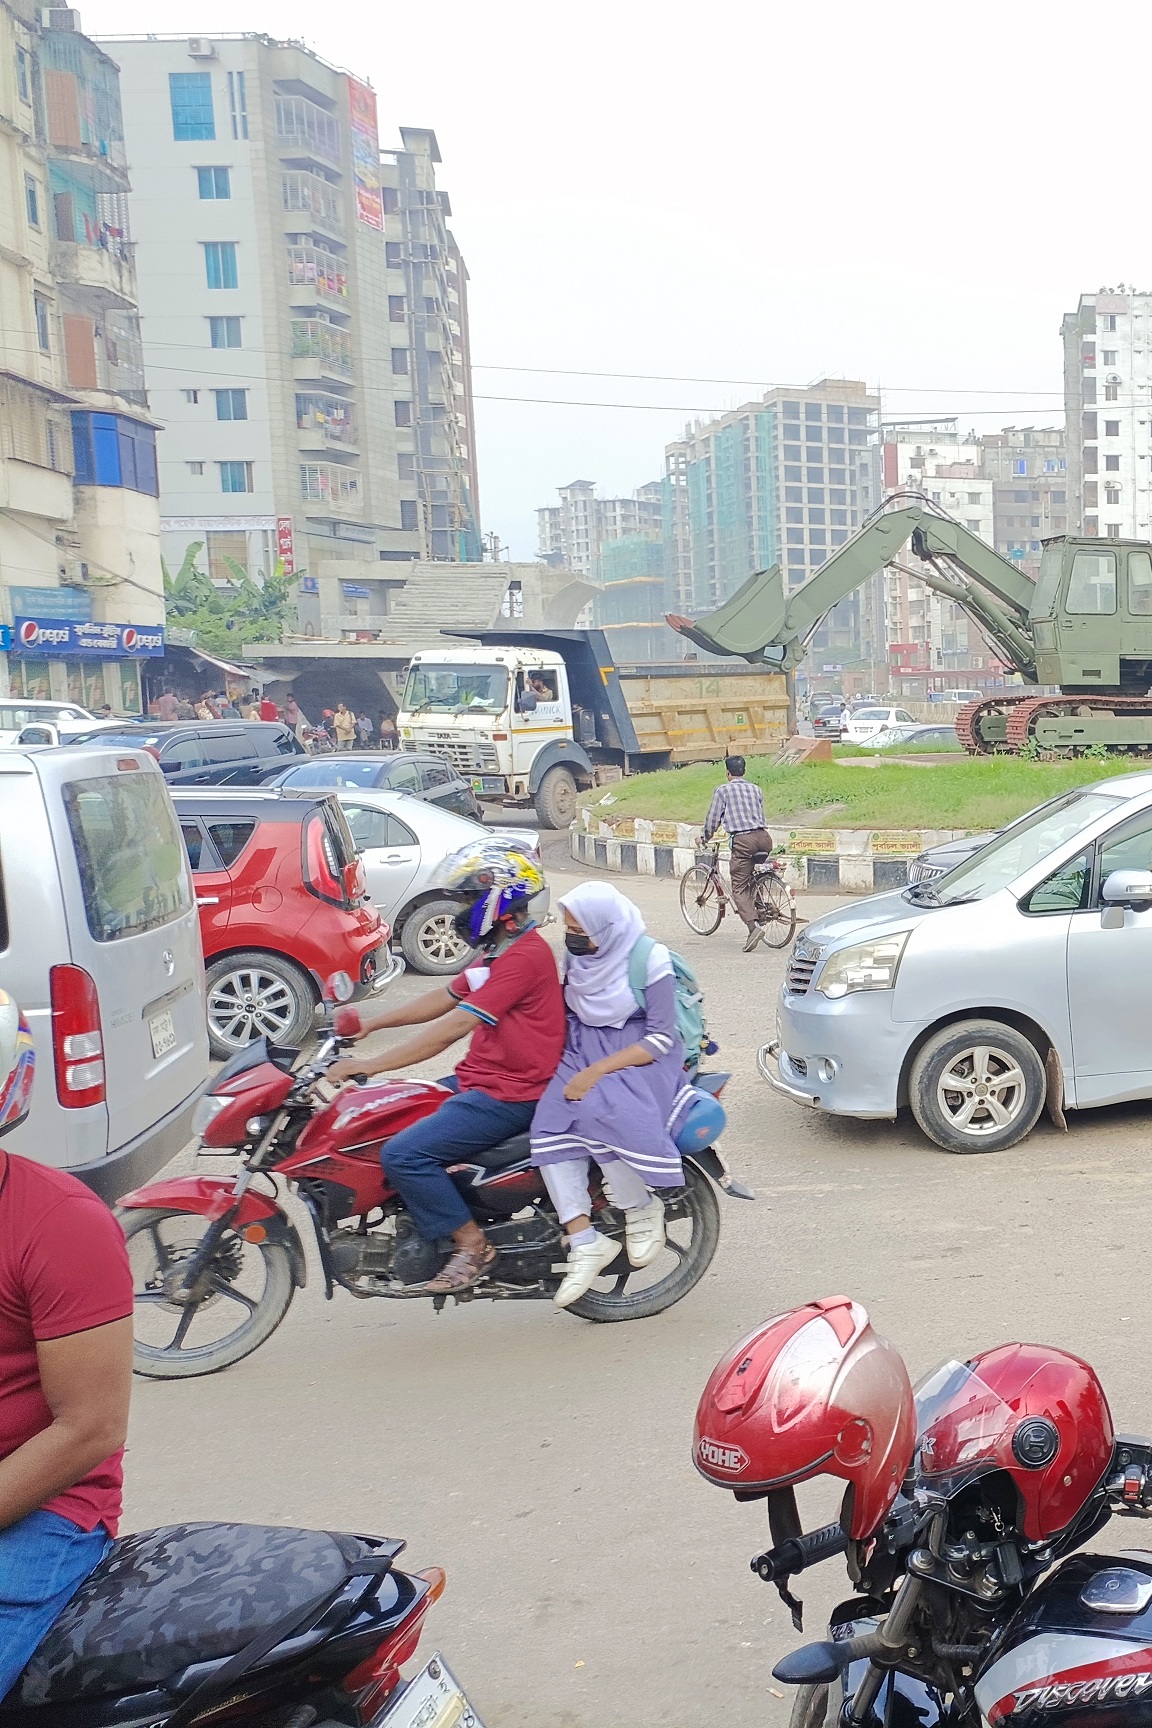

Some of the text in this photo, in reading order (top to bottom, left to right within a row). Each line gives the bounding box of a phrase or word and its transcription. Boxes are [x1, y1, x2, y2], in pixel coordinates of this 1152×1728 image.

[38, 627, 69, 645] pepsi
[137, 633, 162, 649] pepsi
[694, 678, 722, 698] 14
[436, 732, 452, 740] TATA
[700, 1440, 741, 1469] YOHE
